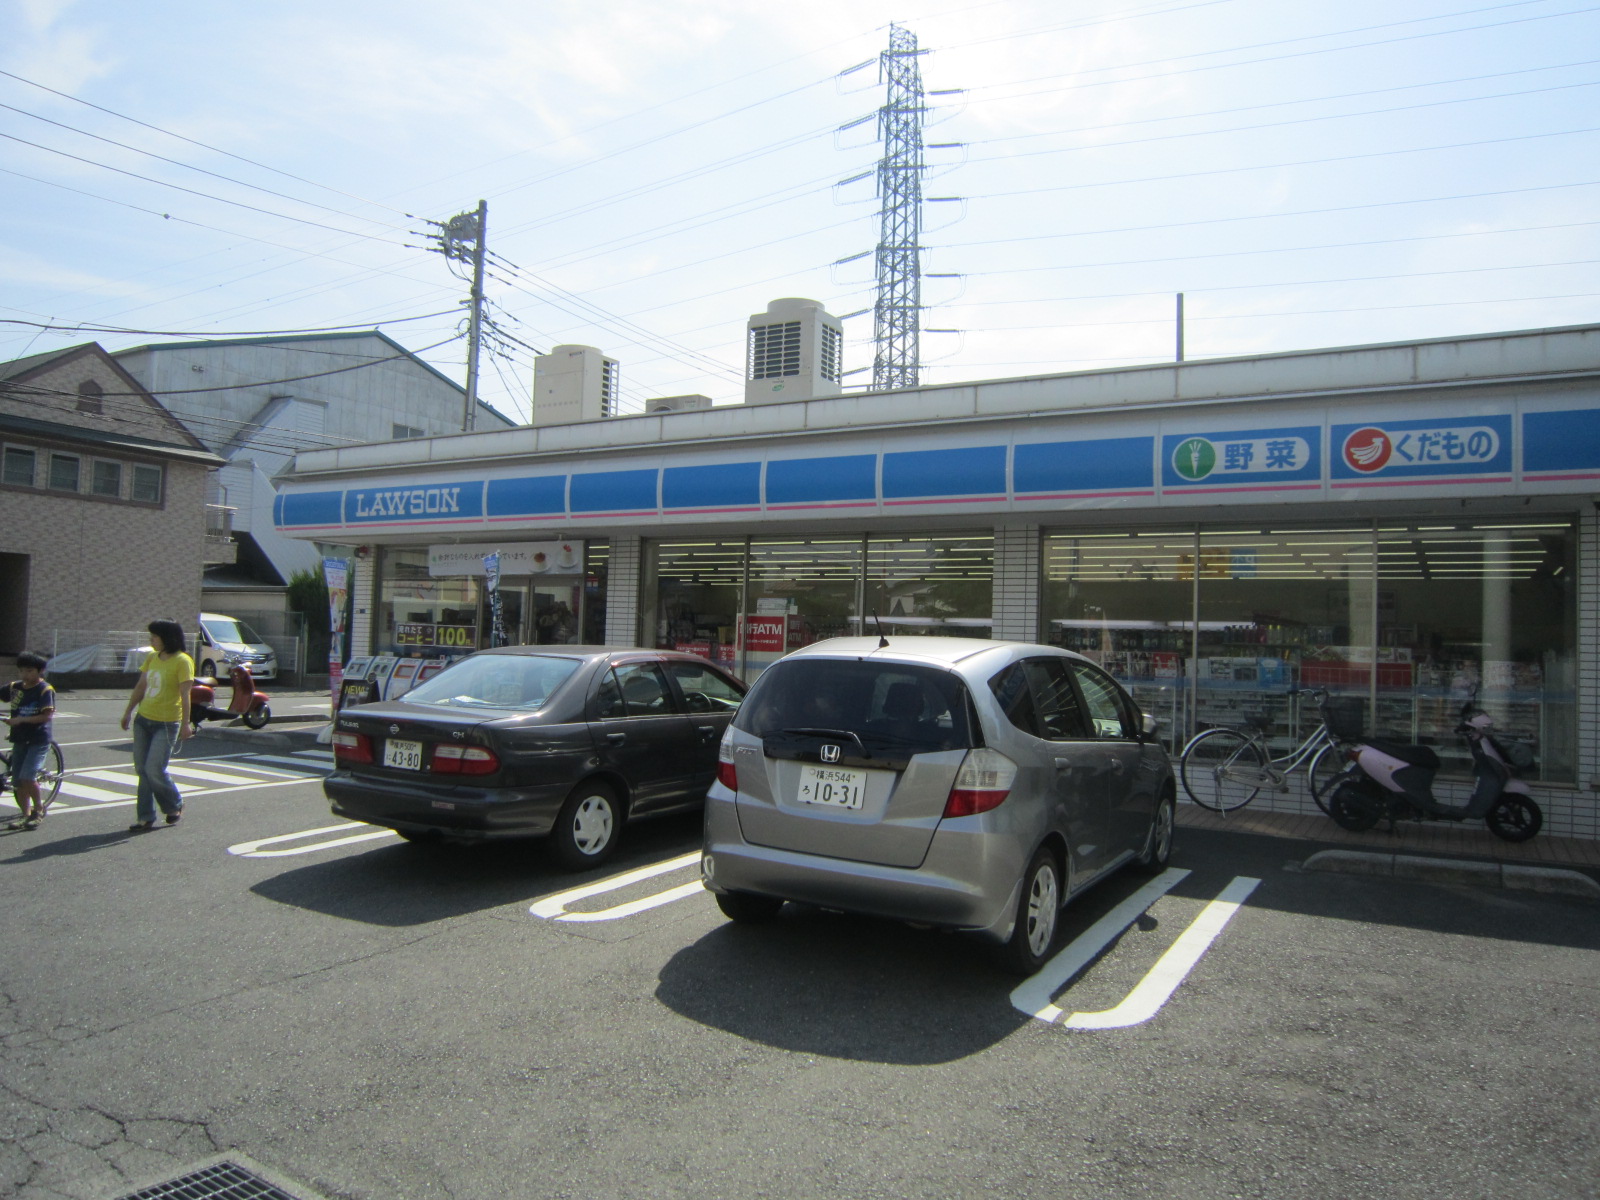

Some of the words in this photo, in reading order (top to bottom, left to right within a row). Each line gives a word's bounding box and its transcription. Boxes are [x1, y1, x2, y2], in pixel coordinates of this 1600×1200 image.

[1224, 439, 1297, 471] 野菜
[1395, 430, 1493, 462] くだもの
[356, 487, 460, 517] LAWSON
[398, 633, 434, 645] コーヒー
[802, 784, 811, 795] ろ
[814, 782, 859, 806] 10-31
